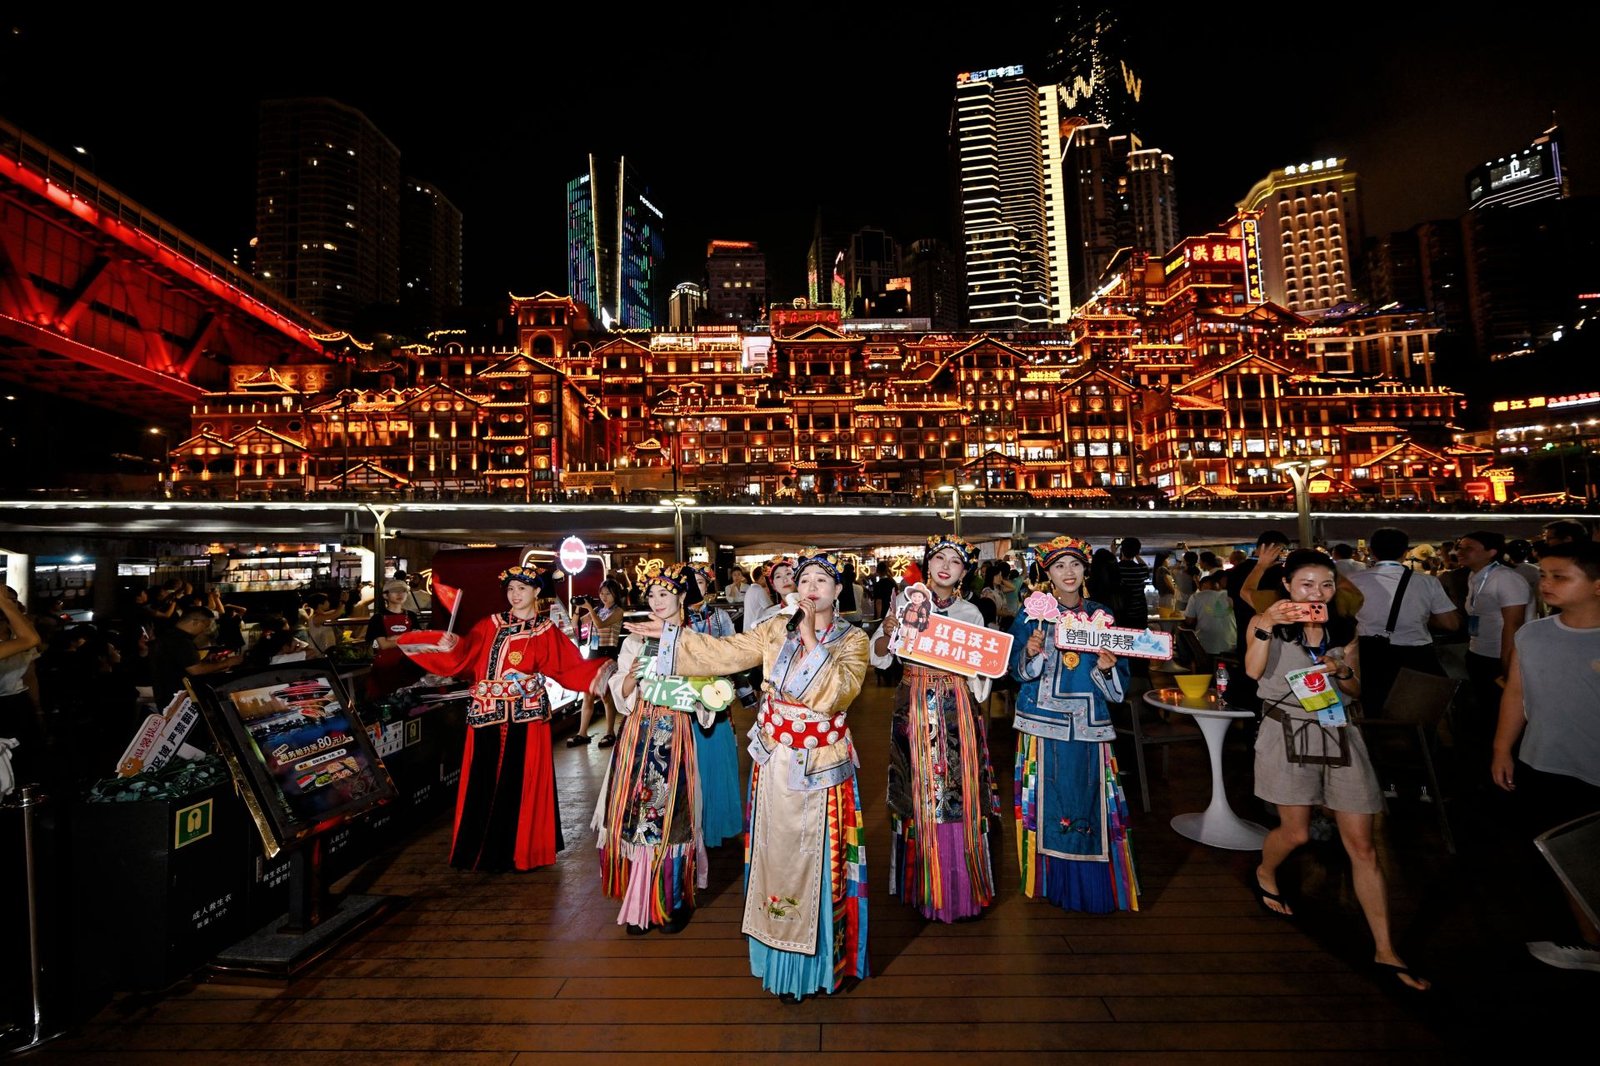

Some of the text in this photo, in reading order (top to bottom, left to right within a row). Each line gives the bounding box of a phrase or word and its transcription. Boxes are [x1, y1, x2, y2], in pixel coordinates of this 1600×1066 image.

[1192, 244, 1242, 262] 洪崖洞
[917, 635, 984, 668] 康养小金
[934, 622, 999, 654] 红色沃土
[1065, 628, 1135, 651] 登雪山赏美景
